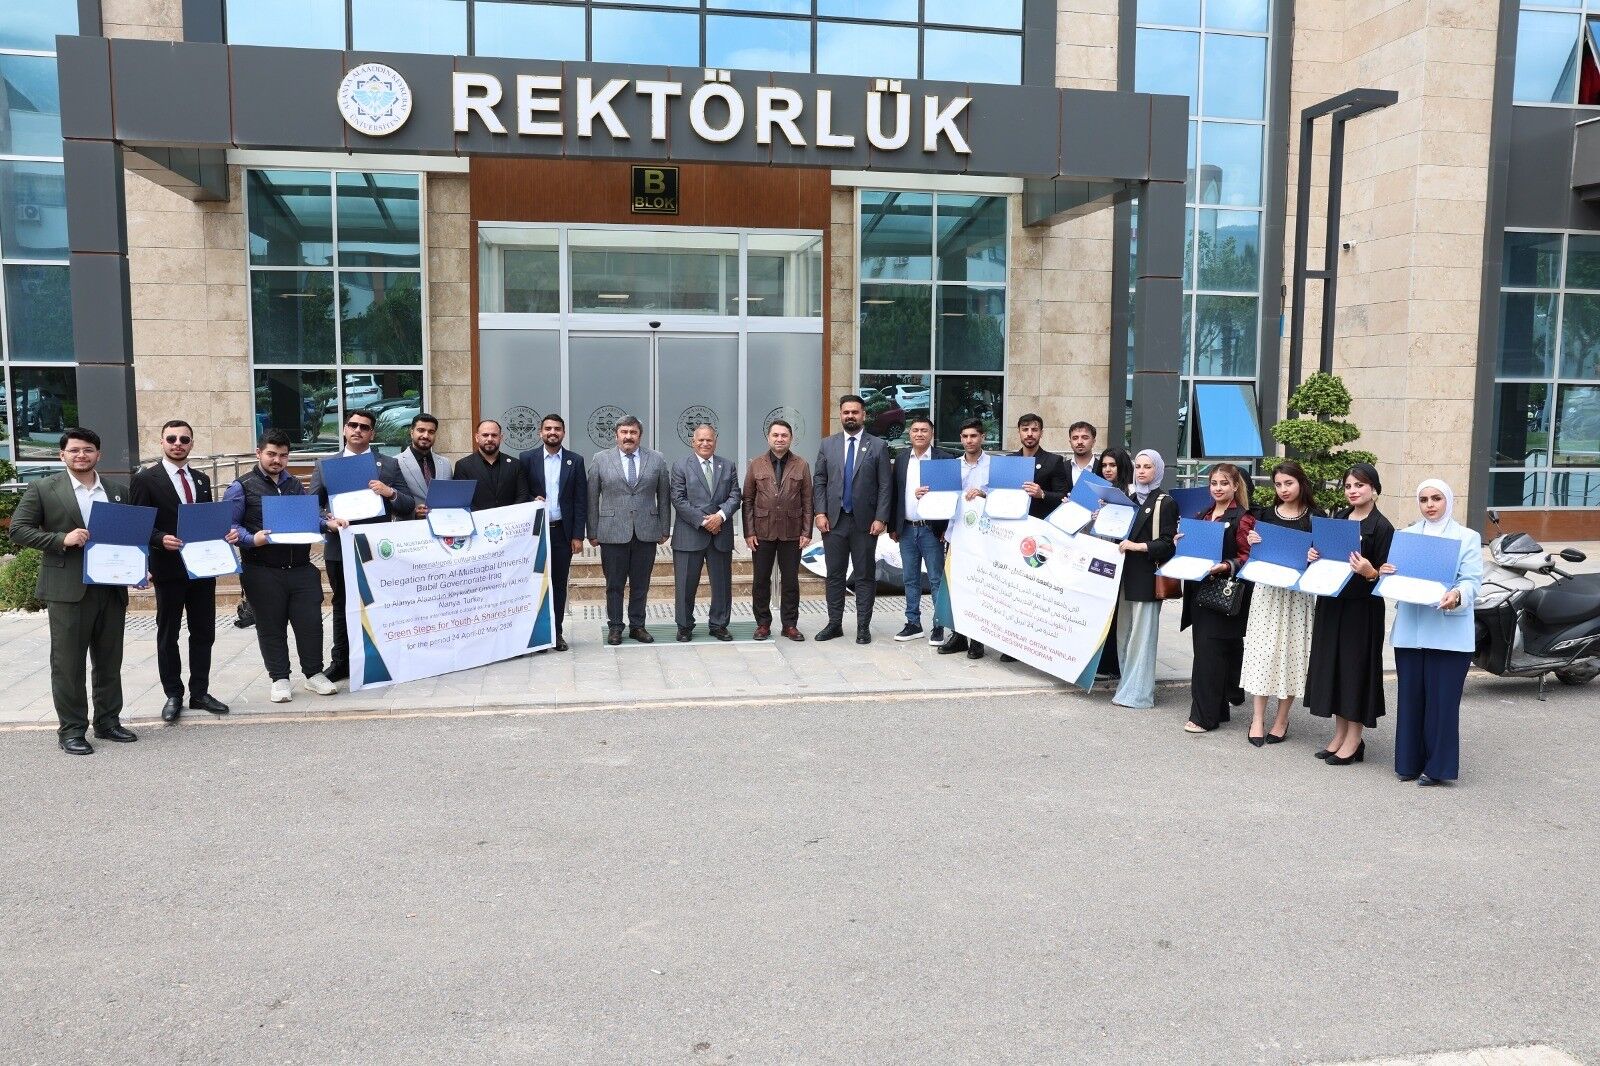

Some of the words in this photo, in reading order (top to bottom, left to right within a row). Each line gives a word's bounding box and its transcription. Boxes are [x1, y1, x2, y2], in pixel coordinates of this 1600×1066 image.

[452, 69, 973, 154] REKTÖRLÜK
[644, 170, 666, 194] B
[634, 196, 676, 211] BLOK
[412, 559, 453, 570] International
[453, 555, 477, 565] cultural
[478, 550, 505, 561] exchange
[380, 575, 426, 588] Delegation
[428, 573, 447, 582] from
[448, 563, 496, 578] Al-Mustaqbal
[416, 582, 438, 593] Babil
[392, 598, 416, 607] Alanya
[478, 582, 508, 592] University
[384, 628, 412, 640] "Green
[412, 624, 437, 634] Steps
[438, 621, 449, 630] for
[482, 609, 507, 620] Shared
[507, 603, 532, 617] Future"
[407, 641, 416, 650] for
[417, 639, 428, 649] the
[429, 635, 451, 649] period
[487, 625, 498, 634] May
